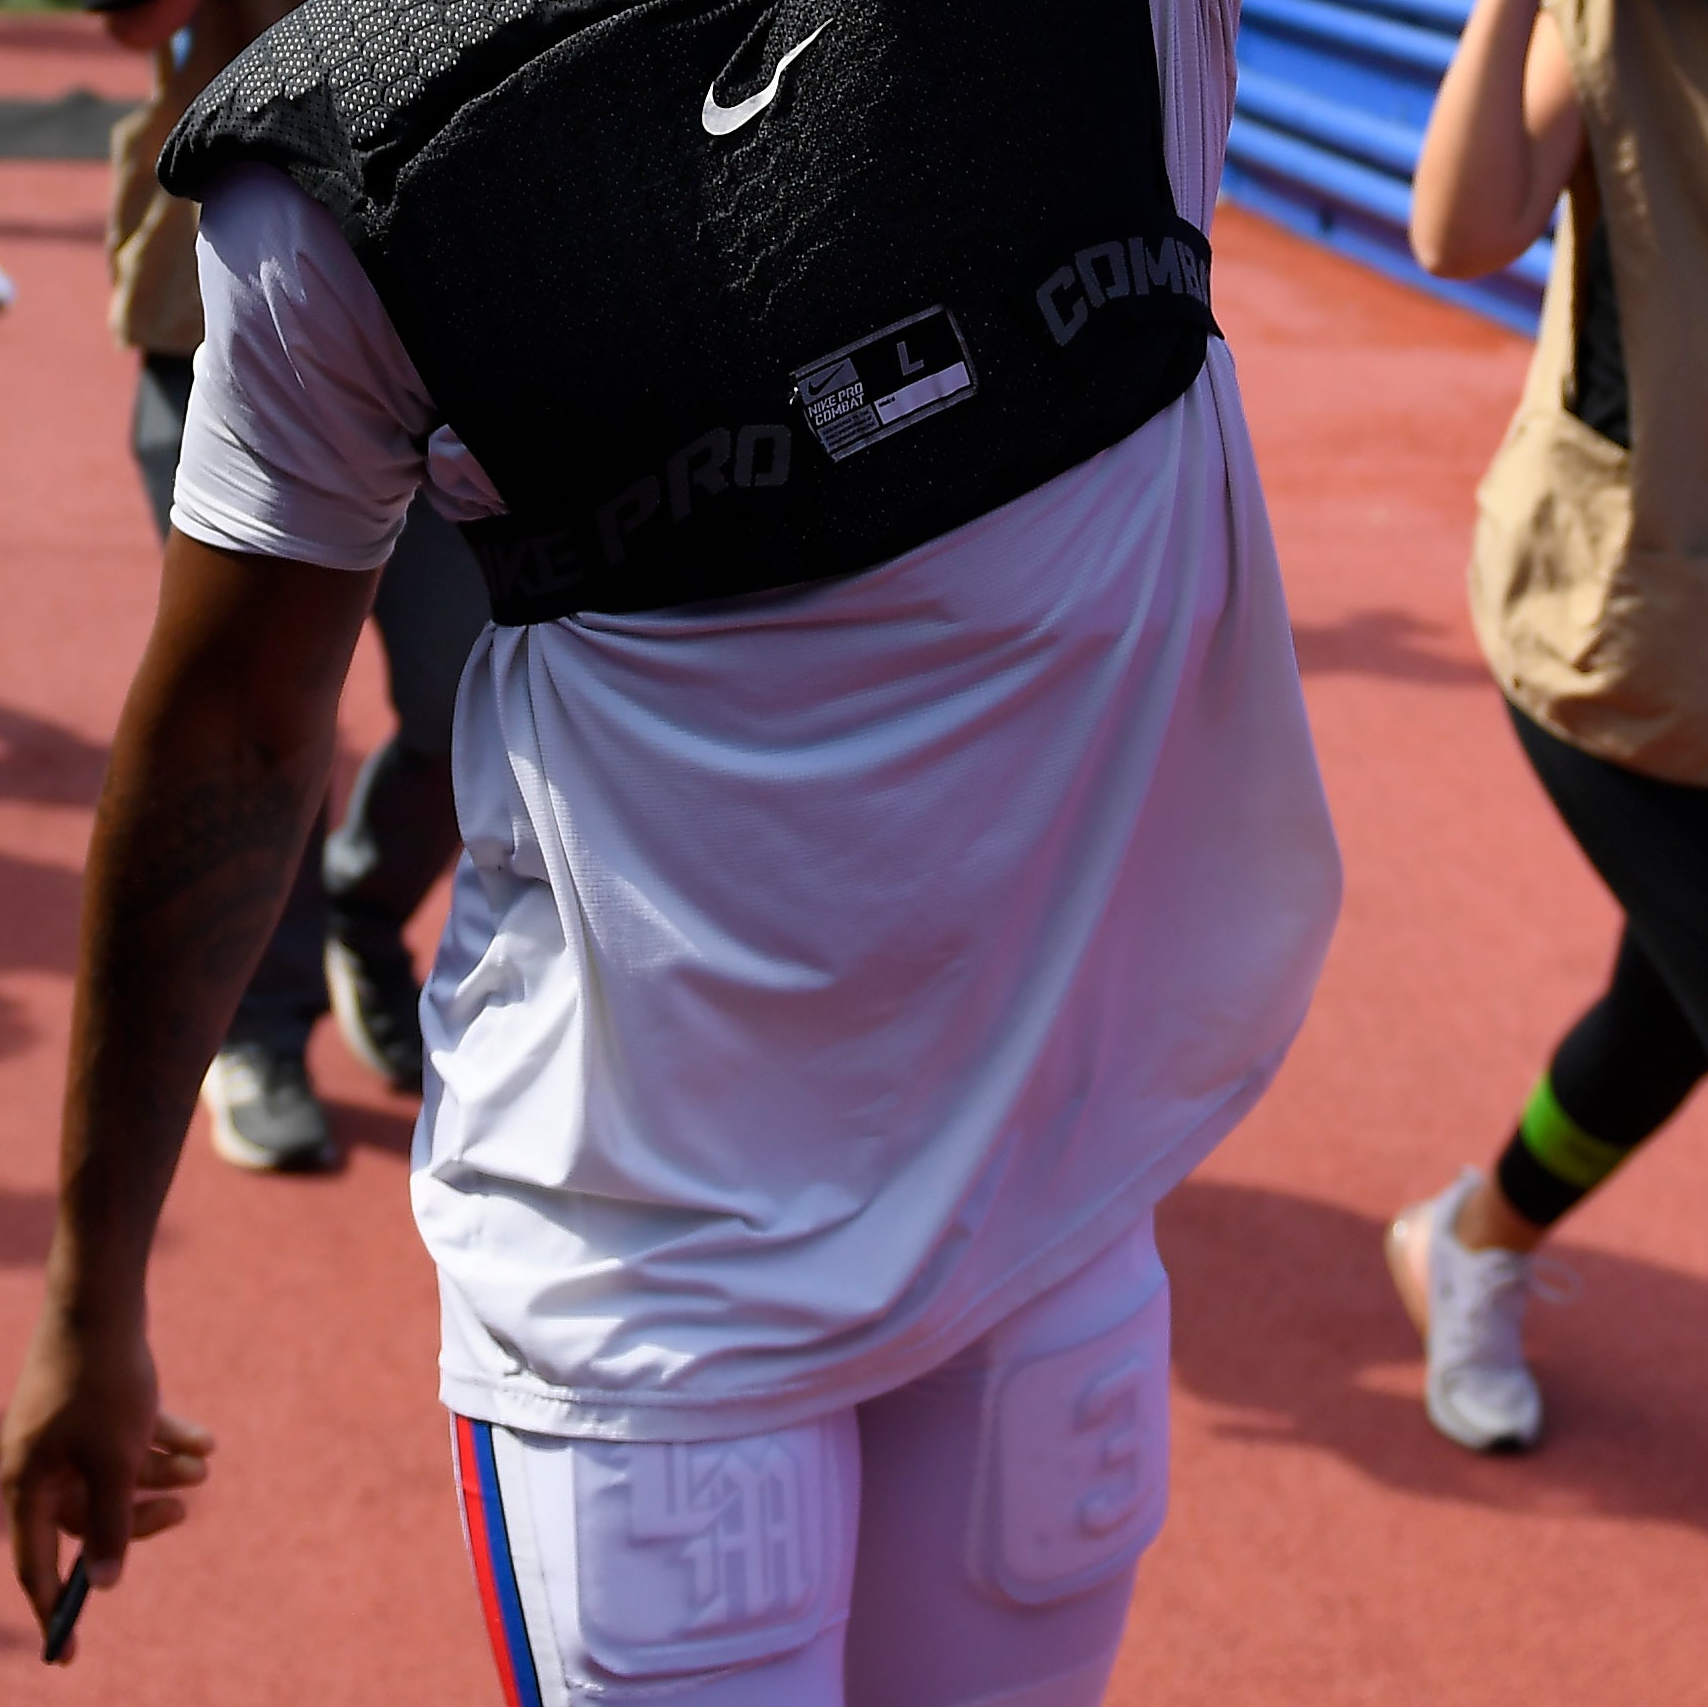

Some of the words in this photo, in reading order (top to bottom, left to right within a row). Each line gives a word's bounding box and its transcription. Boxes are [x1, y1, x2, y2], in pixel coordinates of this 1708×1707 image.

[896, 340, 925, 376] L
[807, 394, 837, 418] NIKE
[837, 381, 863, 402] PRO
[814, 392, 864, 426] COMBAT
[595, 422, 793, 568] PRO
